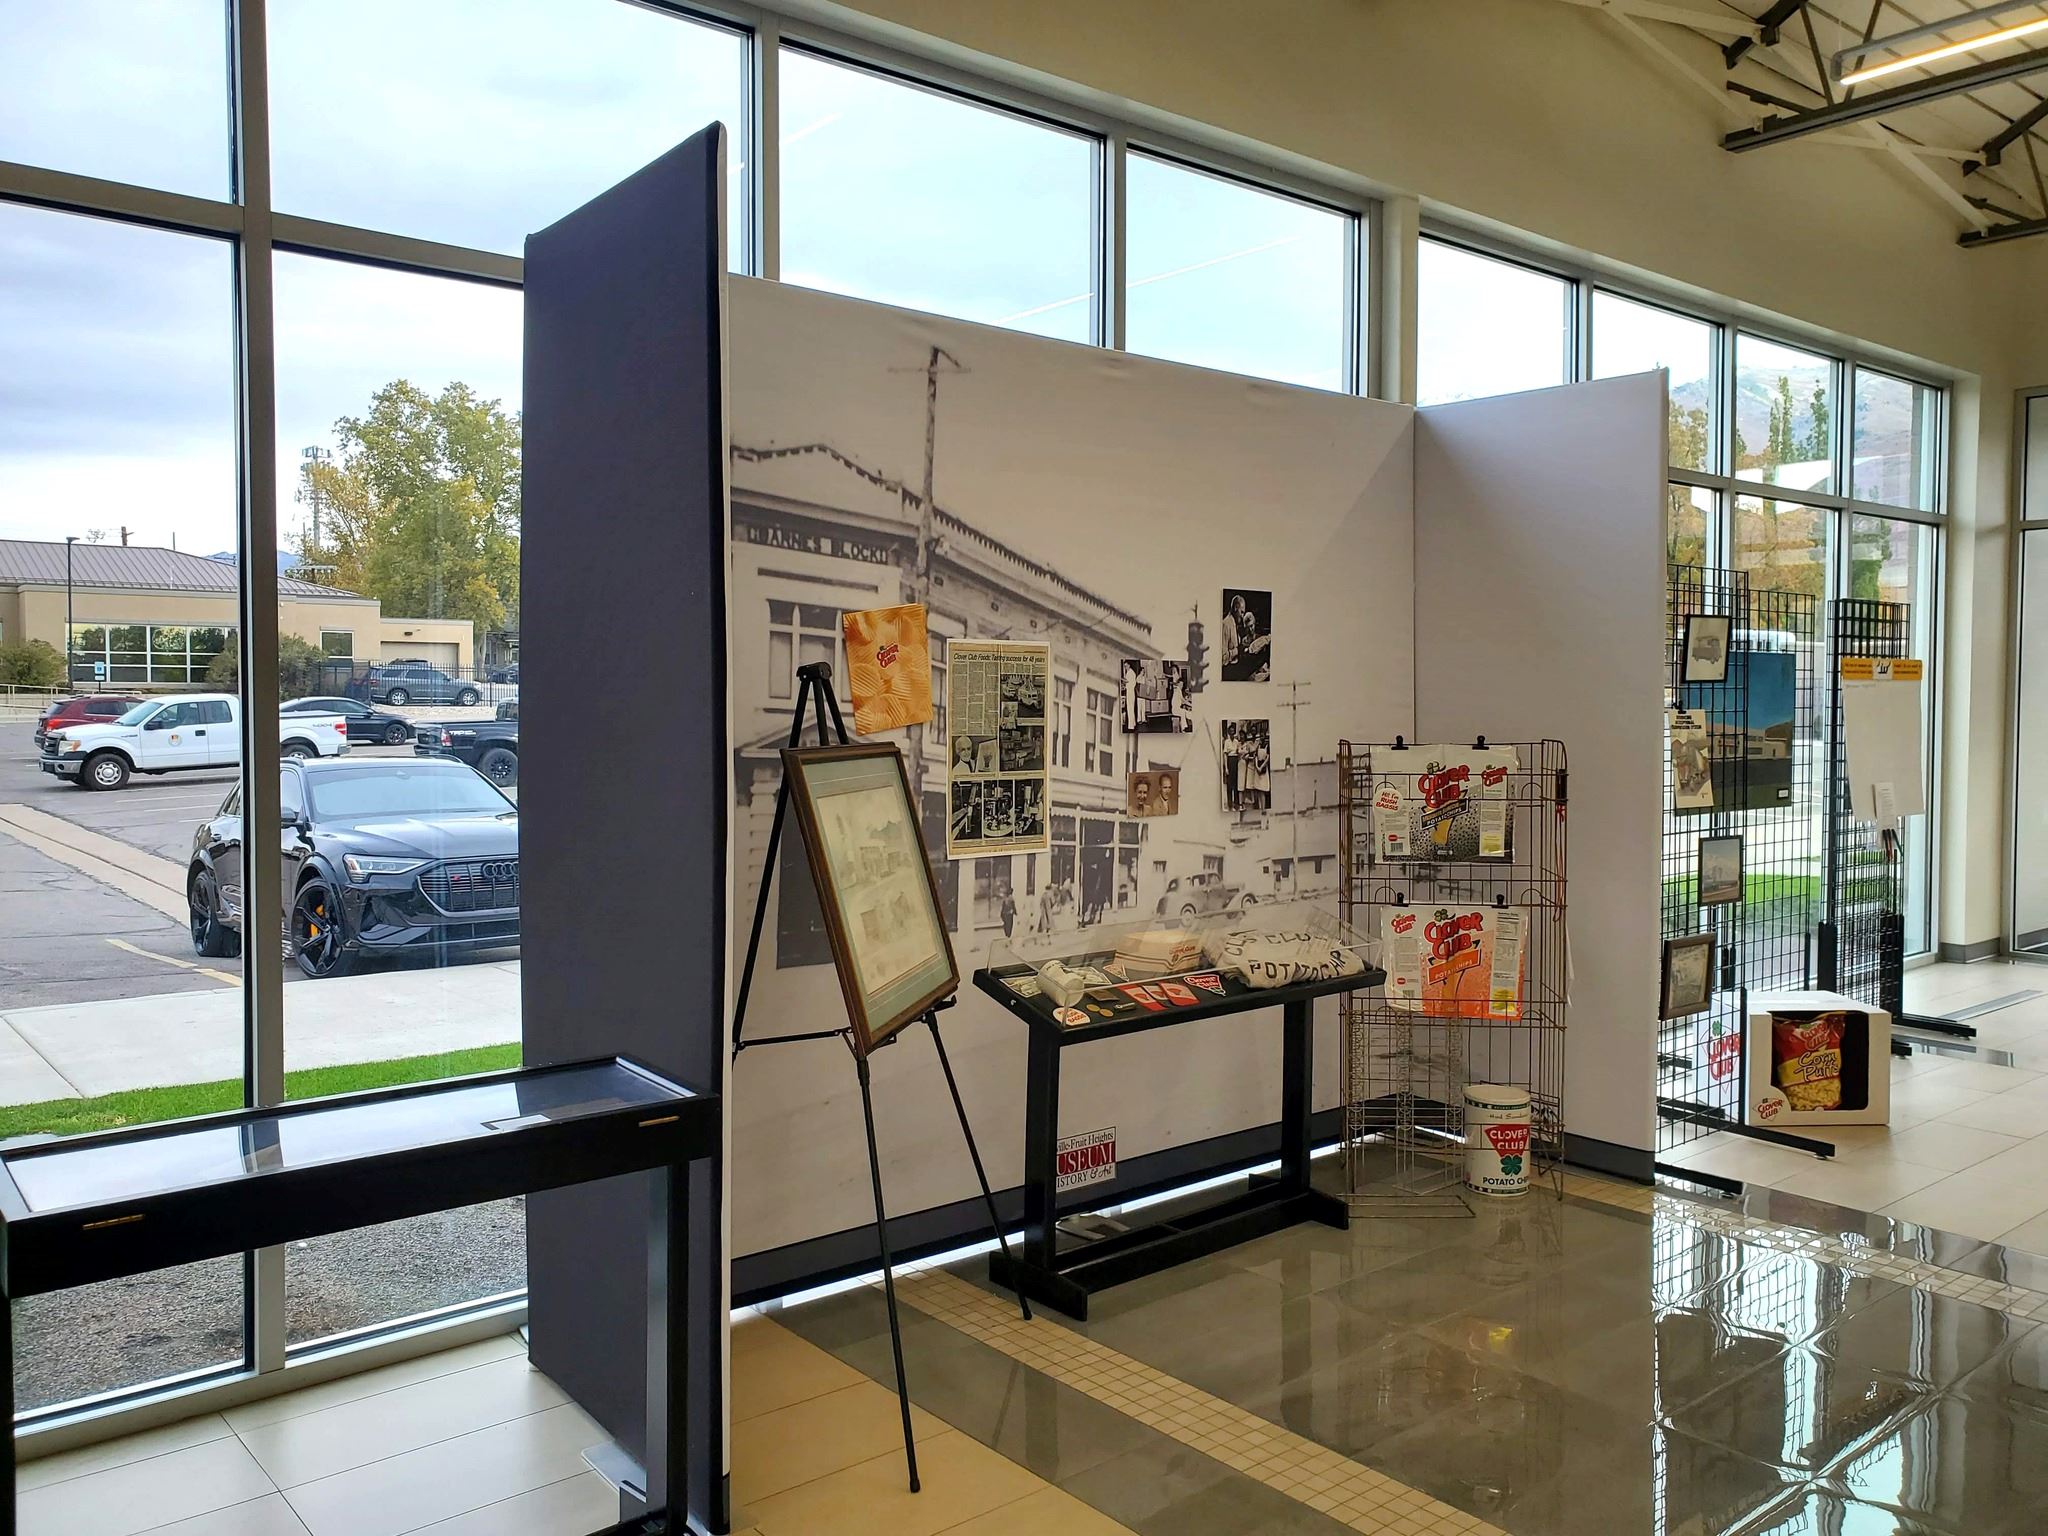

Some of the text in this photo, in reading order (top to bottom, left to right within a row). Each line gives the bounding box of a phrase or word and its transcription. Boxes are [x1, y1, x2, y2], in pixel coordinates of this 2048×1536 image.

[1798, 1050, 1838, 1067] Corn
[1794, 1063, 1840, 1082] Puffs
[1088, 1131, 1114, 1145] Heights
[1489, 1128, 1528, 1140] CLOVER
[1497, 1141, 1525, 1150] CLUB
[1089, 1167, 1099, 1179] &
[1482, 1176, 1515, 1186] POTATO
